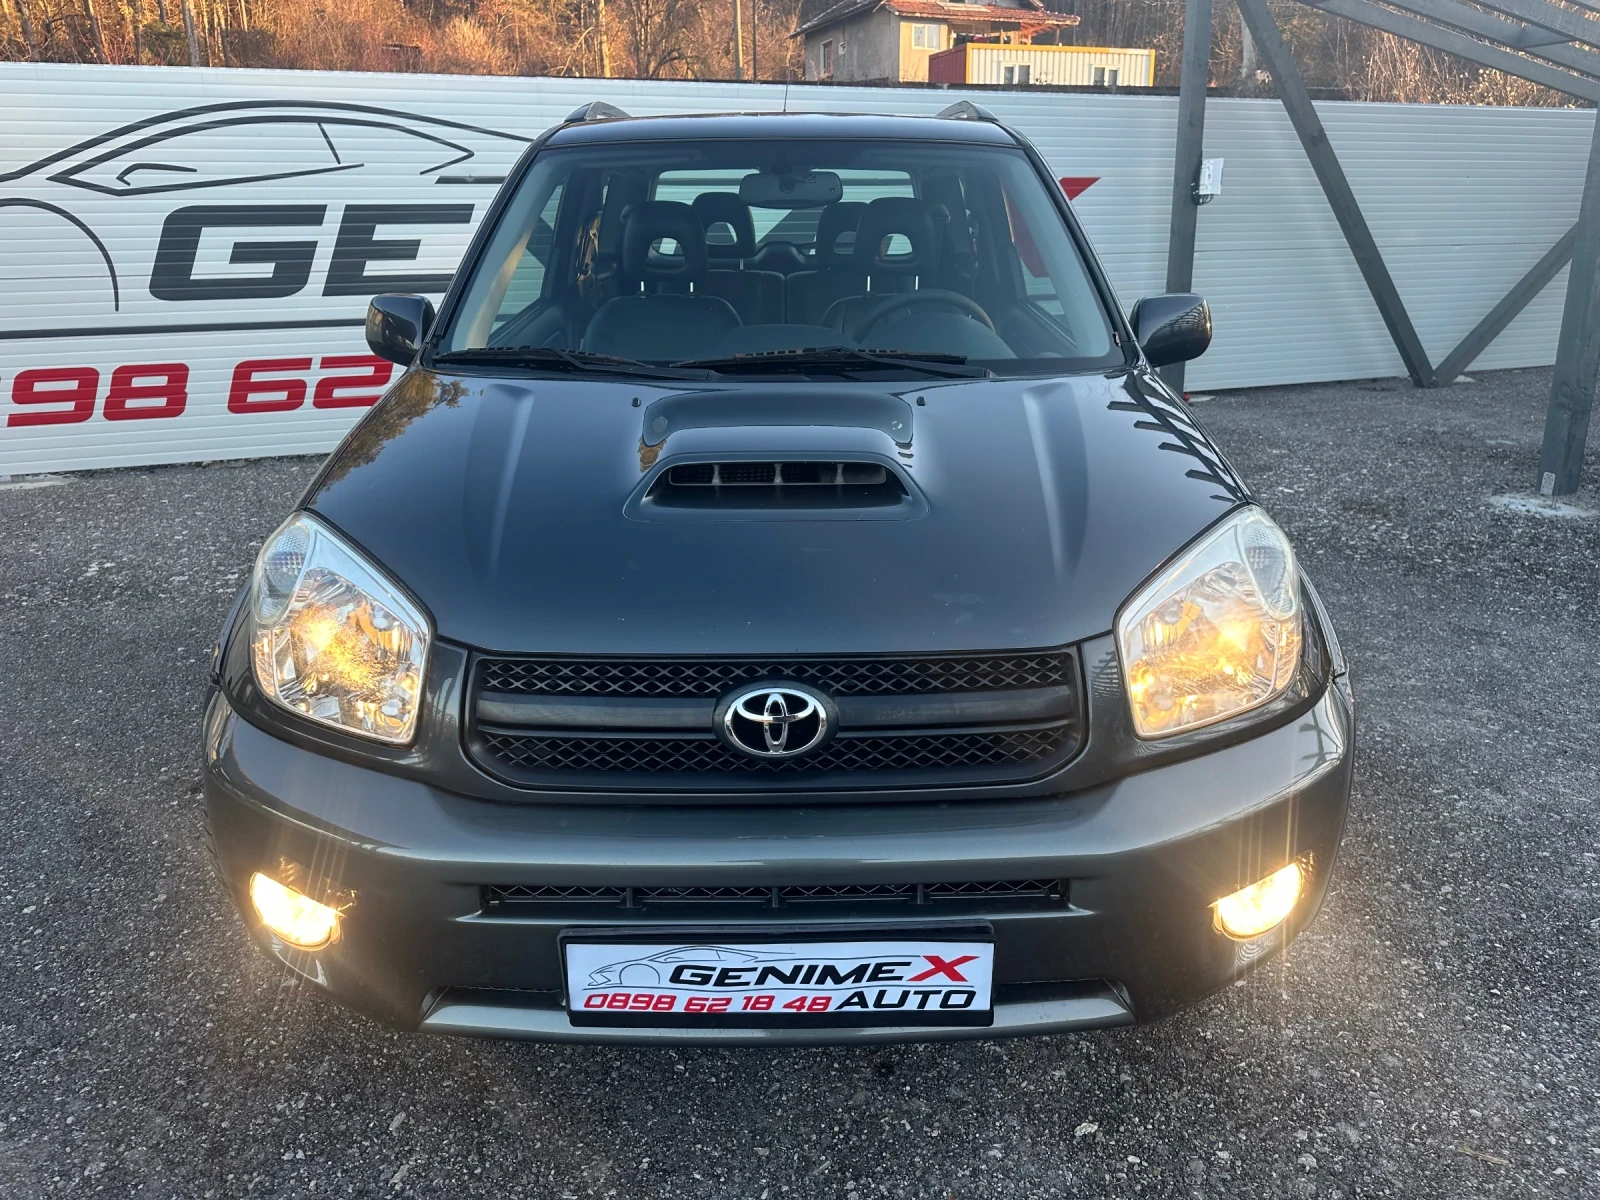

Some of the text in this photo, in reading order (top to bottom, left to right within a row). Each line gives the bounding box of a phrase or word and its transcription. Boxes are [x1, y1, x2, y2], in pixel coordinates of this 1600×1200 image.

[0, 354, 394, 427] 98 62
[668, 954, 981, 987] GENIMEX
[583, 993, 833, 1012] 0898 62 18 48
[834, 989, 977, 1011] AUTO
